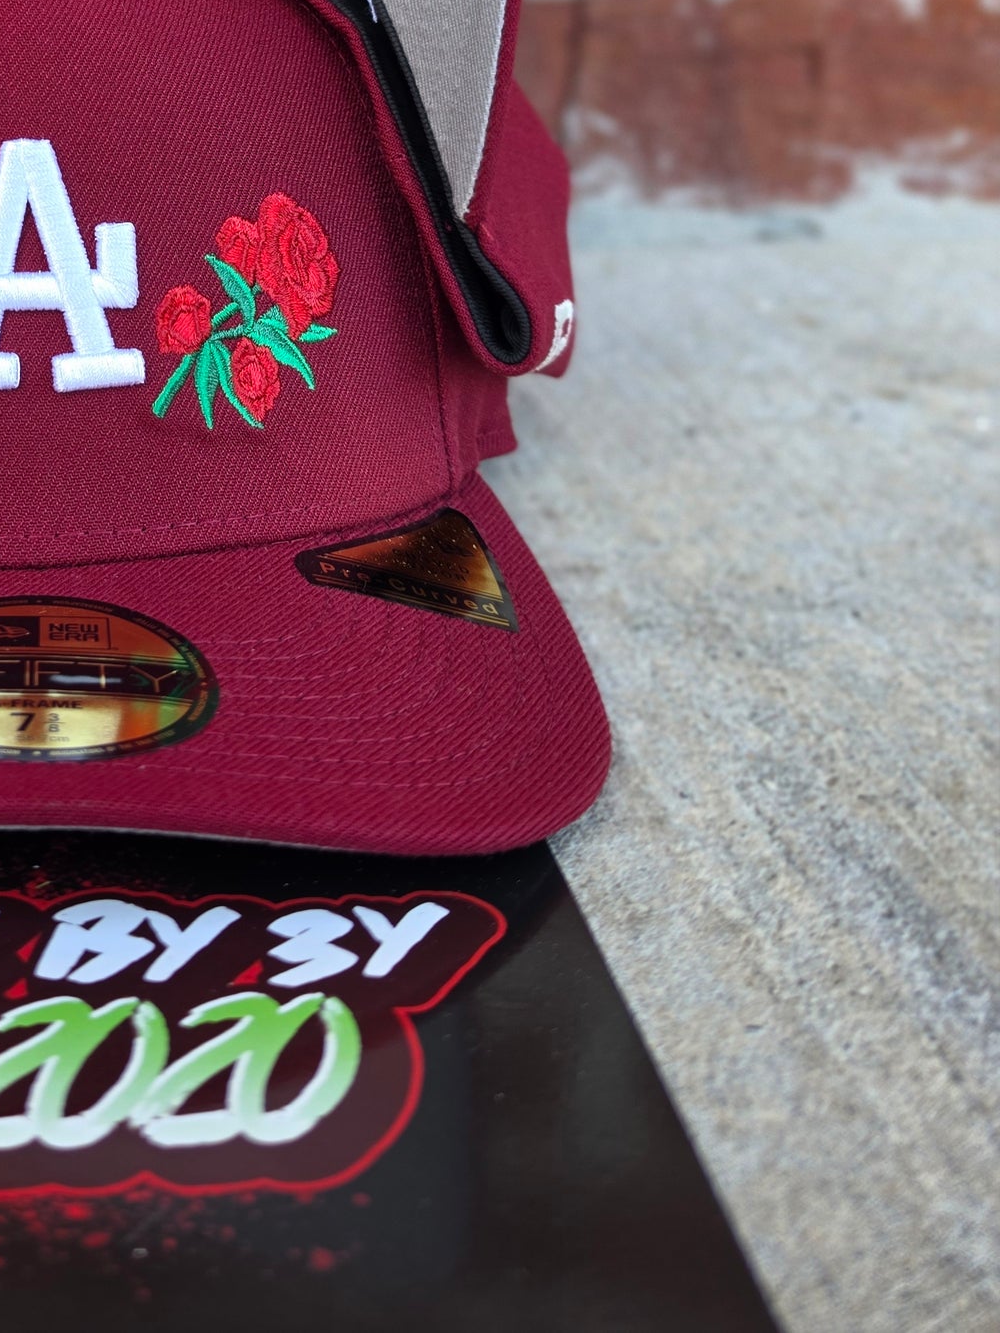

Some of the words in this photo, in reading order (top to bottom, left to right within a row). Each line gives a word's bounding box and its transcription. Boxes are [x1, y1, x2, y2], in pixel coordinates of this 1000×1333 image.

[48, 622, 100, 632] NEW
[48, 632, 100, 643] ERA
[34, 899, 242, 984] BY
